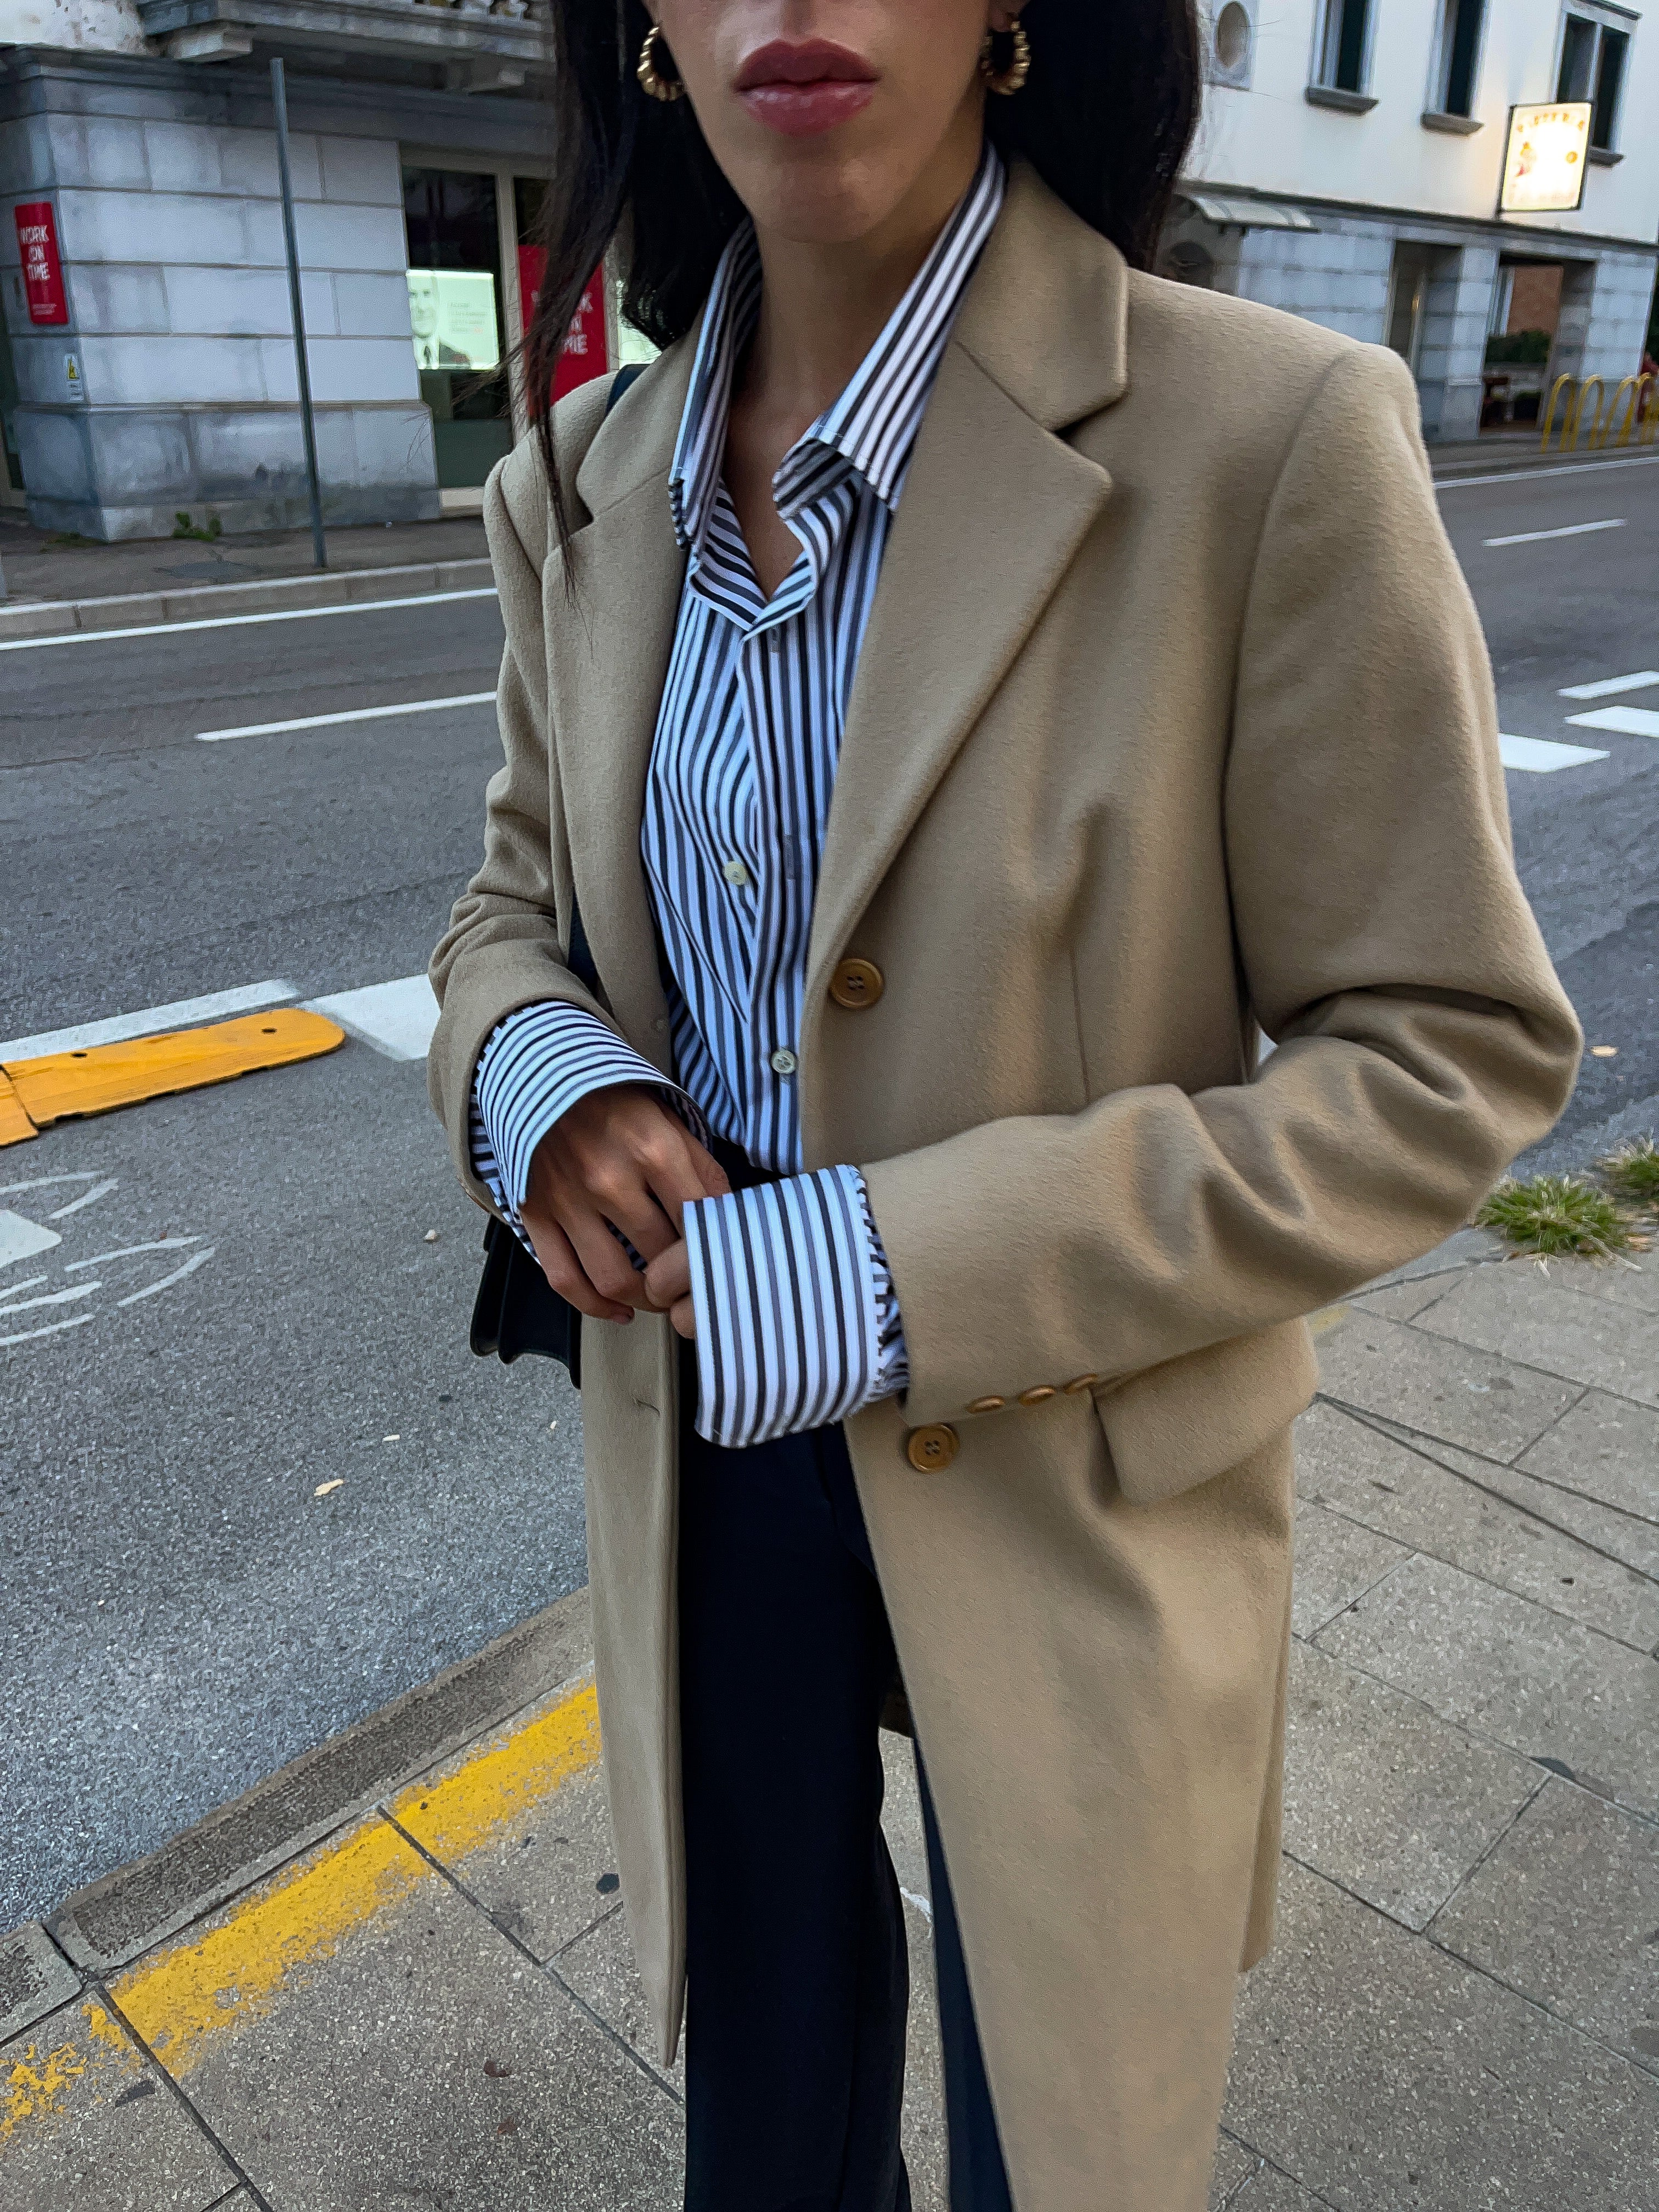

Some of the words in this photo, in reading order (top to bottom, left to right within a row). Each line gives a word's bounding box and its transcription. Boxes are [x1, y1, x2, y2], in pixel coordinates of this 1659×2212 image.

[19, 224, 50, 244] WORK
[29, 245, 45, 262] ON
[27, 262, 50, 281] TIME
